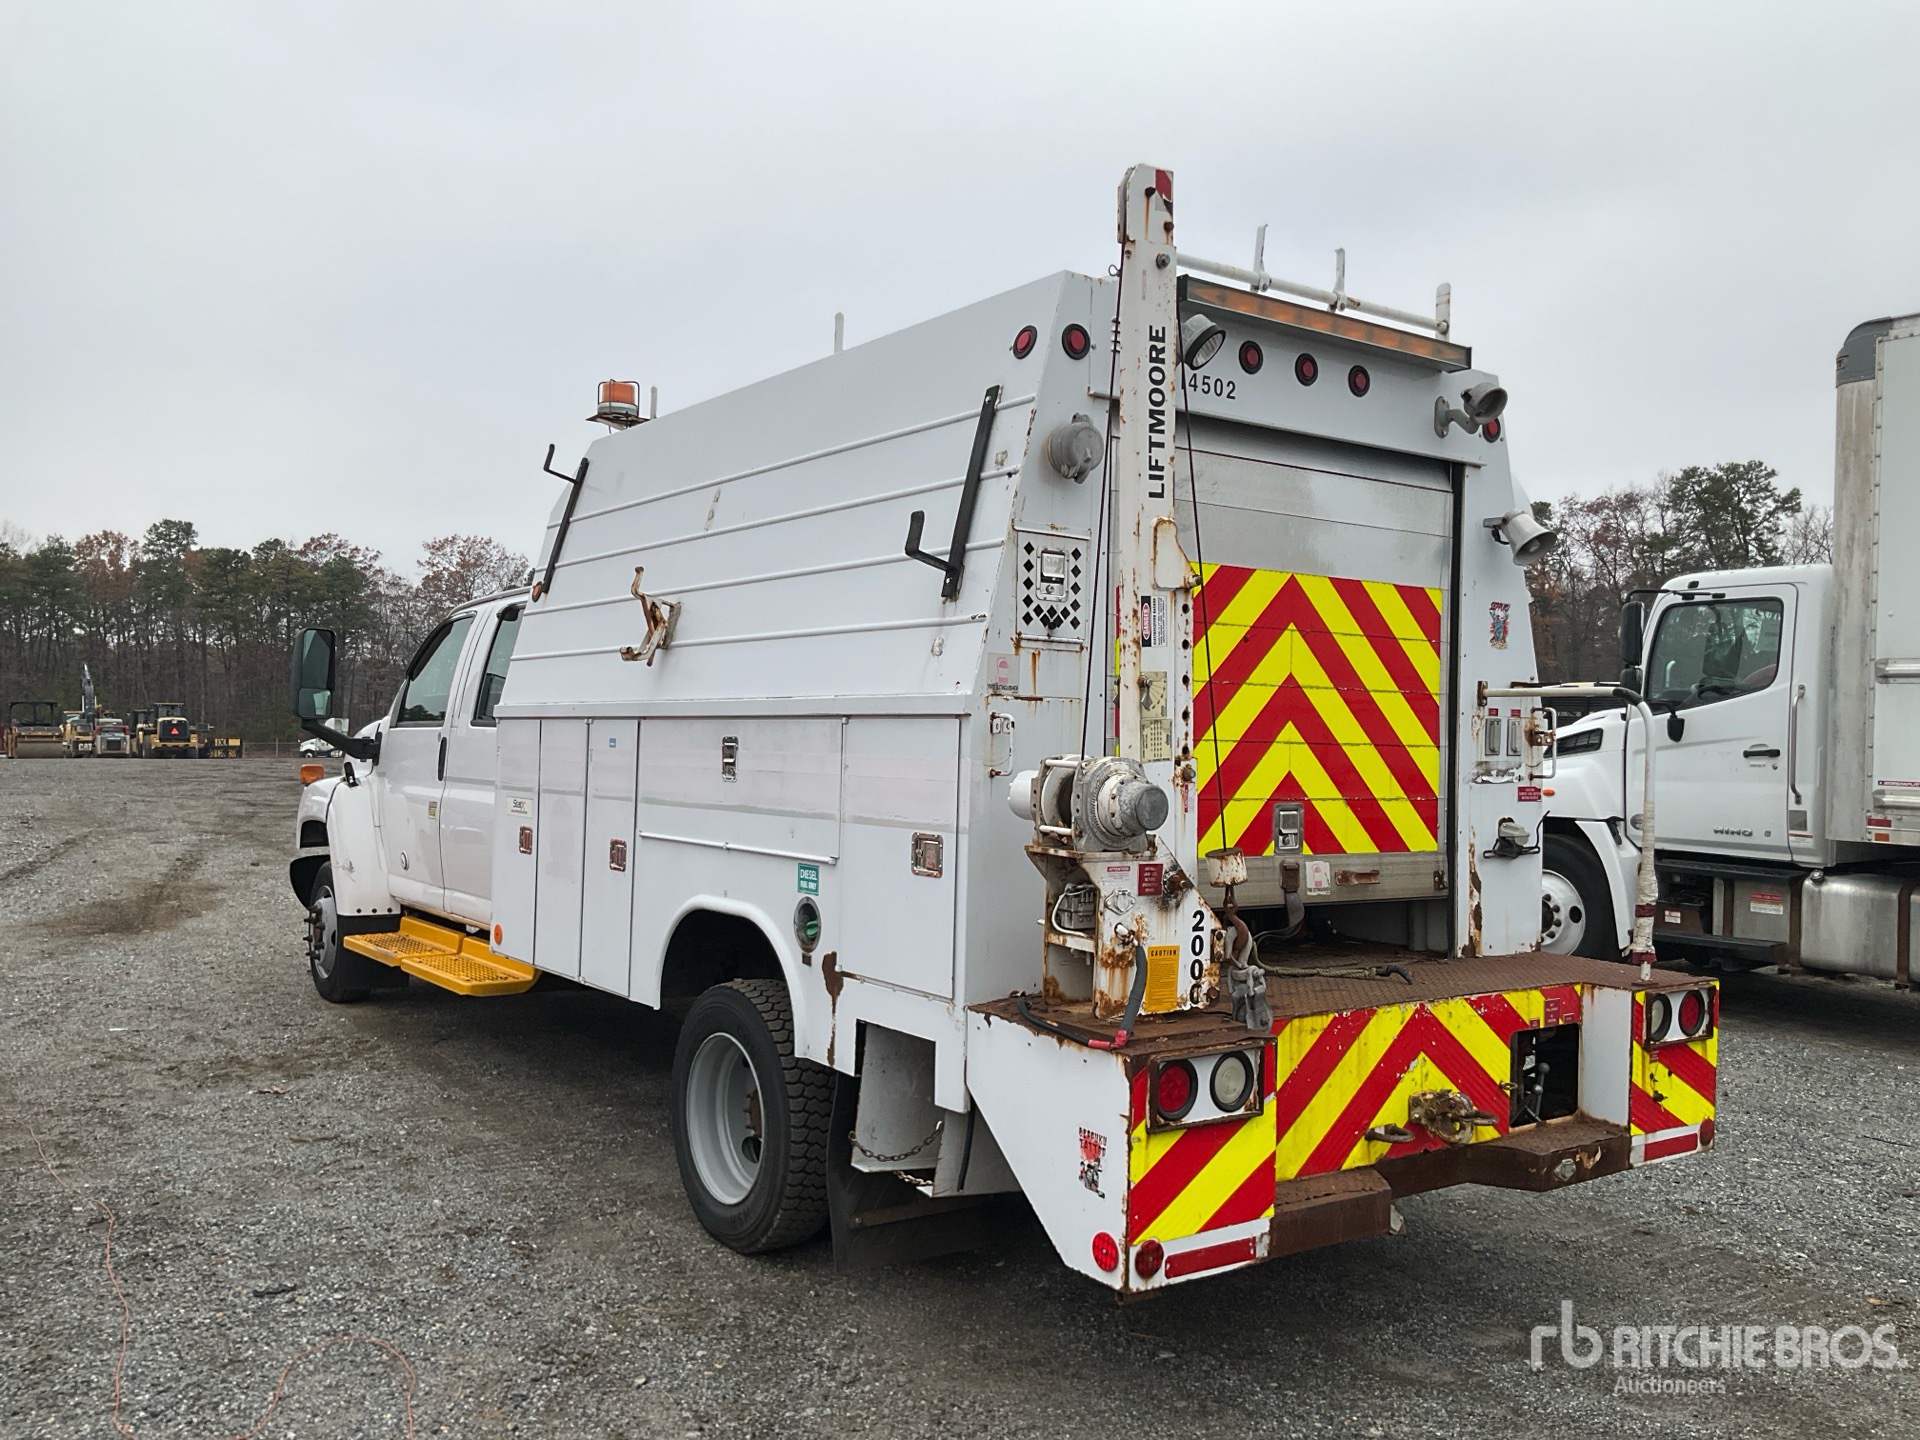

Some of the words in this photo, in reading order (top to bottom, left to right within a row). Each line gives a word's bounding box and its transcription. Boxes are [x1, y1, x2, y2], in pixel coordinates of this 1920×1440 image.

[1148, 324, 1166, 499] LIFTMOORE
[78, 743, 92, 751] CAT
[1713, 827, 1753, 837] HINO
[800, 869, 818, 881] DIESEL
[800, 880, 808, 889] FUEL
[808, 882, 817, 890] ONLY
[1150, 949, 1177, 957] CAUTION
[1189, 909, 1205, 1005] 2000
